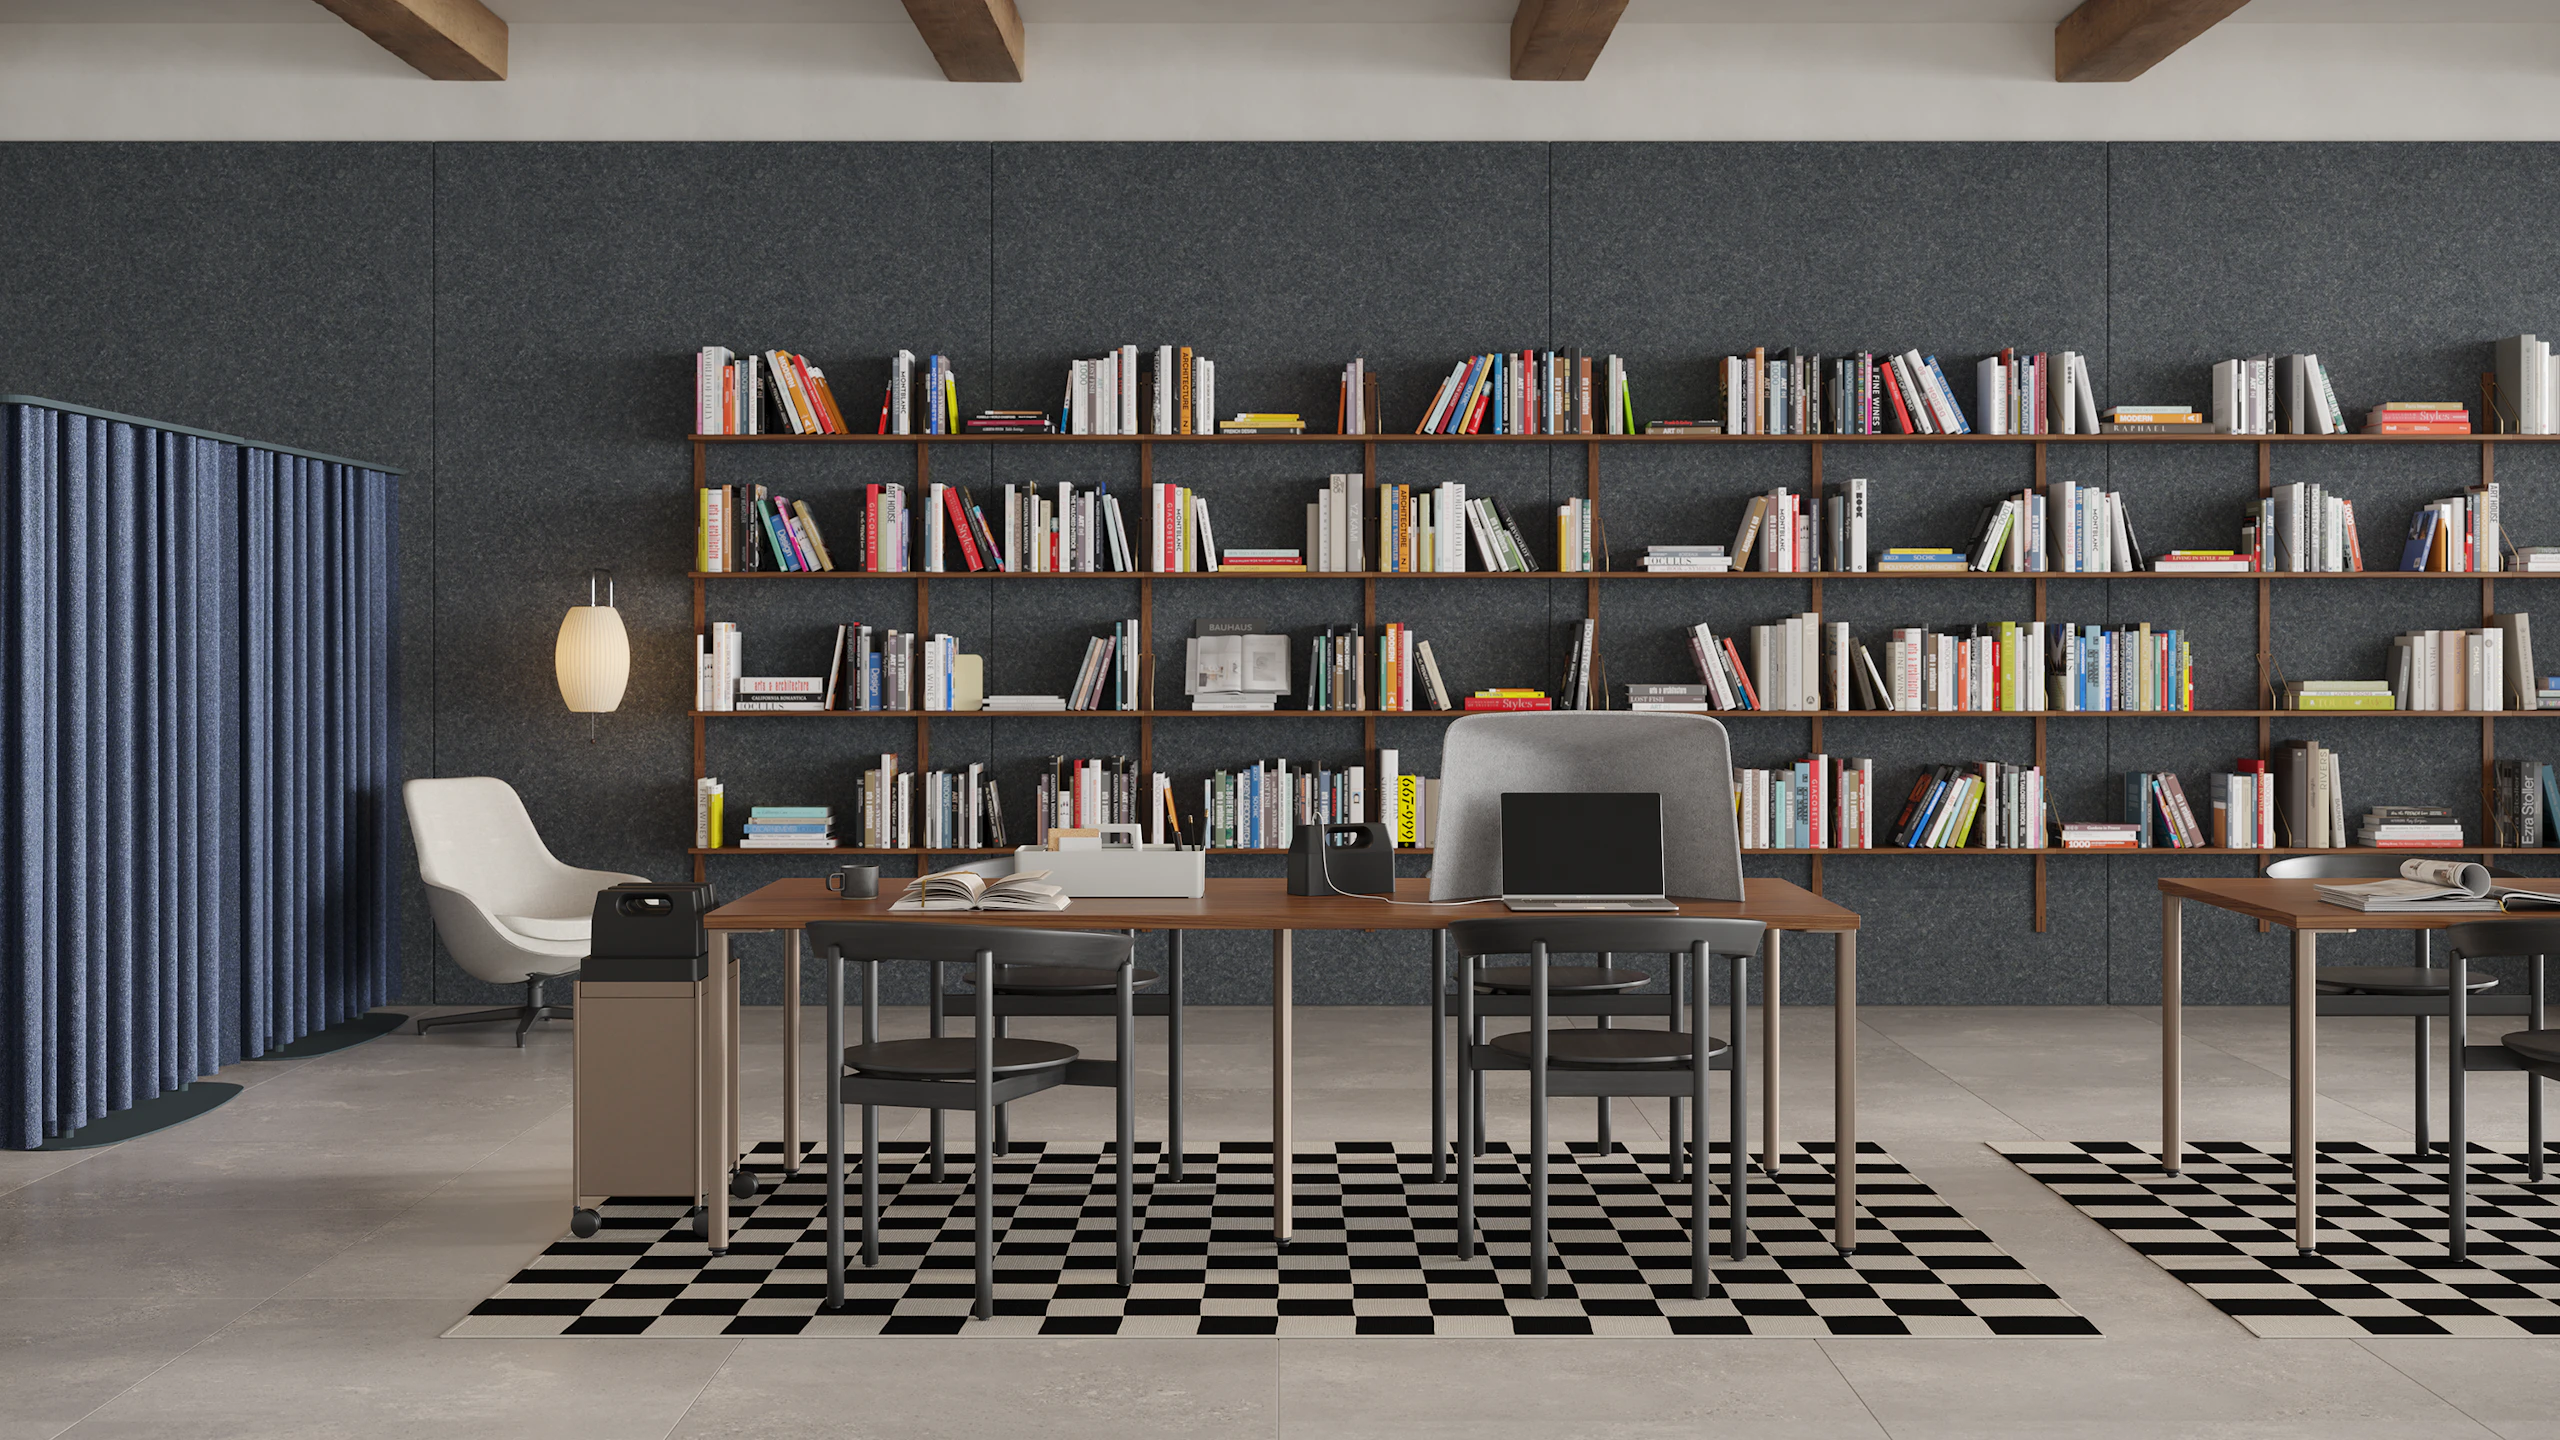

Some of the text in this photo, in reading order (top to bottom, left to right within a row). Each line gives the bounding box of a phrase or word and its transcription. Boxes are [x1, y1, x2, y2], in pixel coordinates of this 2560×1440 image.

[778, 356, 795, 388] MODERN
[1929, 387, 1945, 418] DESIGN
[2420, 411, 2449, 423] Styles
[1998, 504, 2011, 525] 1000
[2068, 499, 2073, 508] 80
[2344, 503, 2354, 525] 1000
[2490, 501, 2498, 523] HOUSE
[1350, 518, 1358, 542] KAMI
[1472, 517, 1480, 529] ART
[777, 529, 793, 557] Design
[957, 523, 974, 554] Styles
[1506, 517, 1529, 557] VERVOORDT
[1581, 624, 1592, 670] DOMESTIC
[870, 668, 880, 696] Design
[1502, 699, 1532, 709] Styles
[699, 788, 707, 840] FINE WINES
[1402, 778, 1414, 839] 667-999
[1745, 799, 1751, 808] ON
[1948, 795, 1956, 807] ART
[2522, 775, 2534, 844] Ezra Stoller
